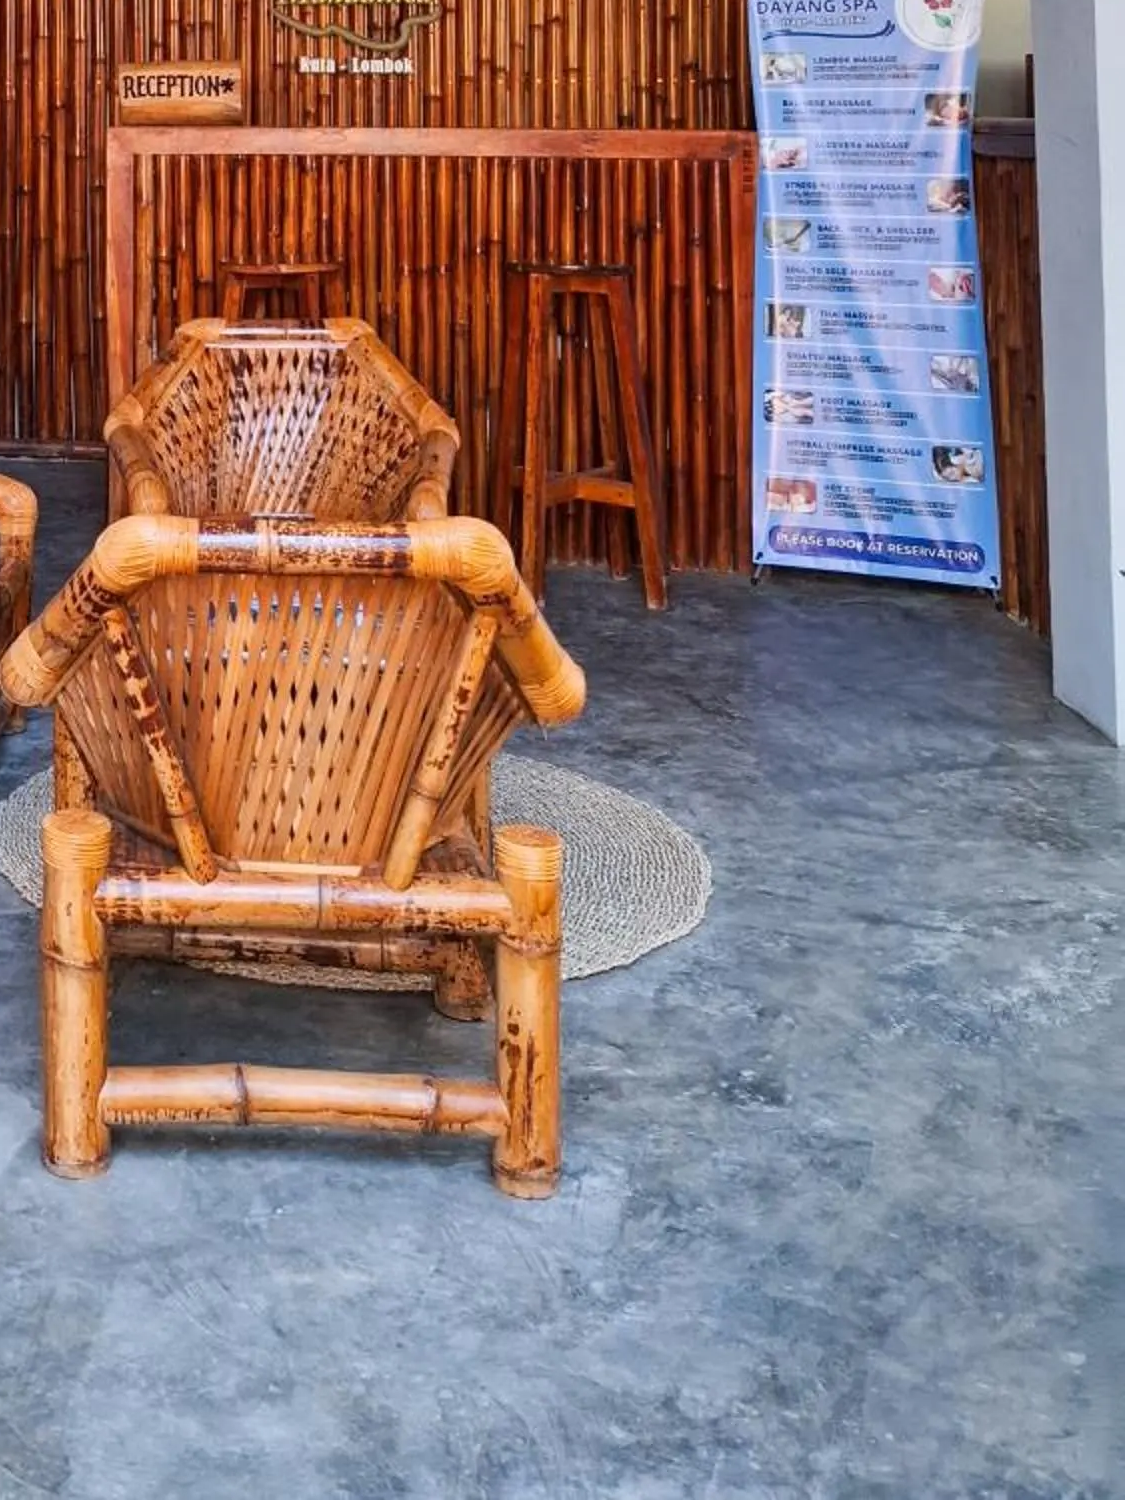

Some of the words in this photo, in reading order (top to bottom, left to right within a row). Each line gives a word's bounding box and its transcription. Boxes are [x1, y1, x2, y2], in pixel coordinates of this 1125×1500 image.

[757, 0, 836, 15] DAYANG
[352, 56, 413, 74] Lombok
[776, 531, 825, 547] PLEASE
[826, 536, 865, 551] BOOK
[887, 543, 979, 563] RESERVATION
